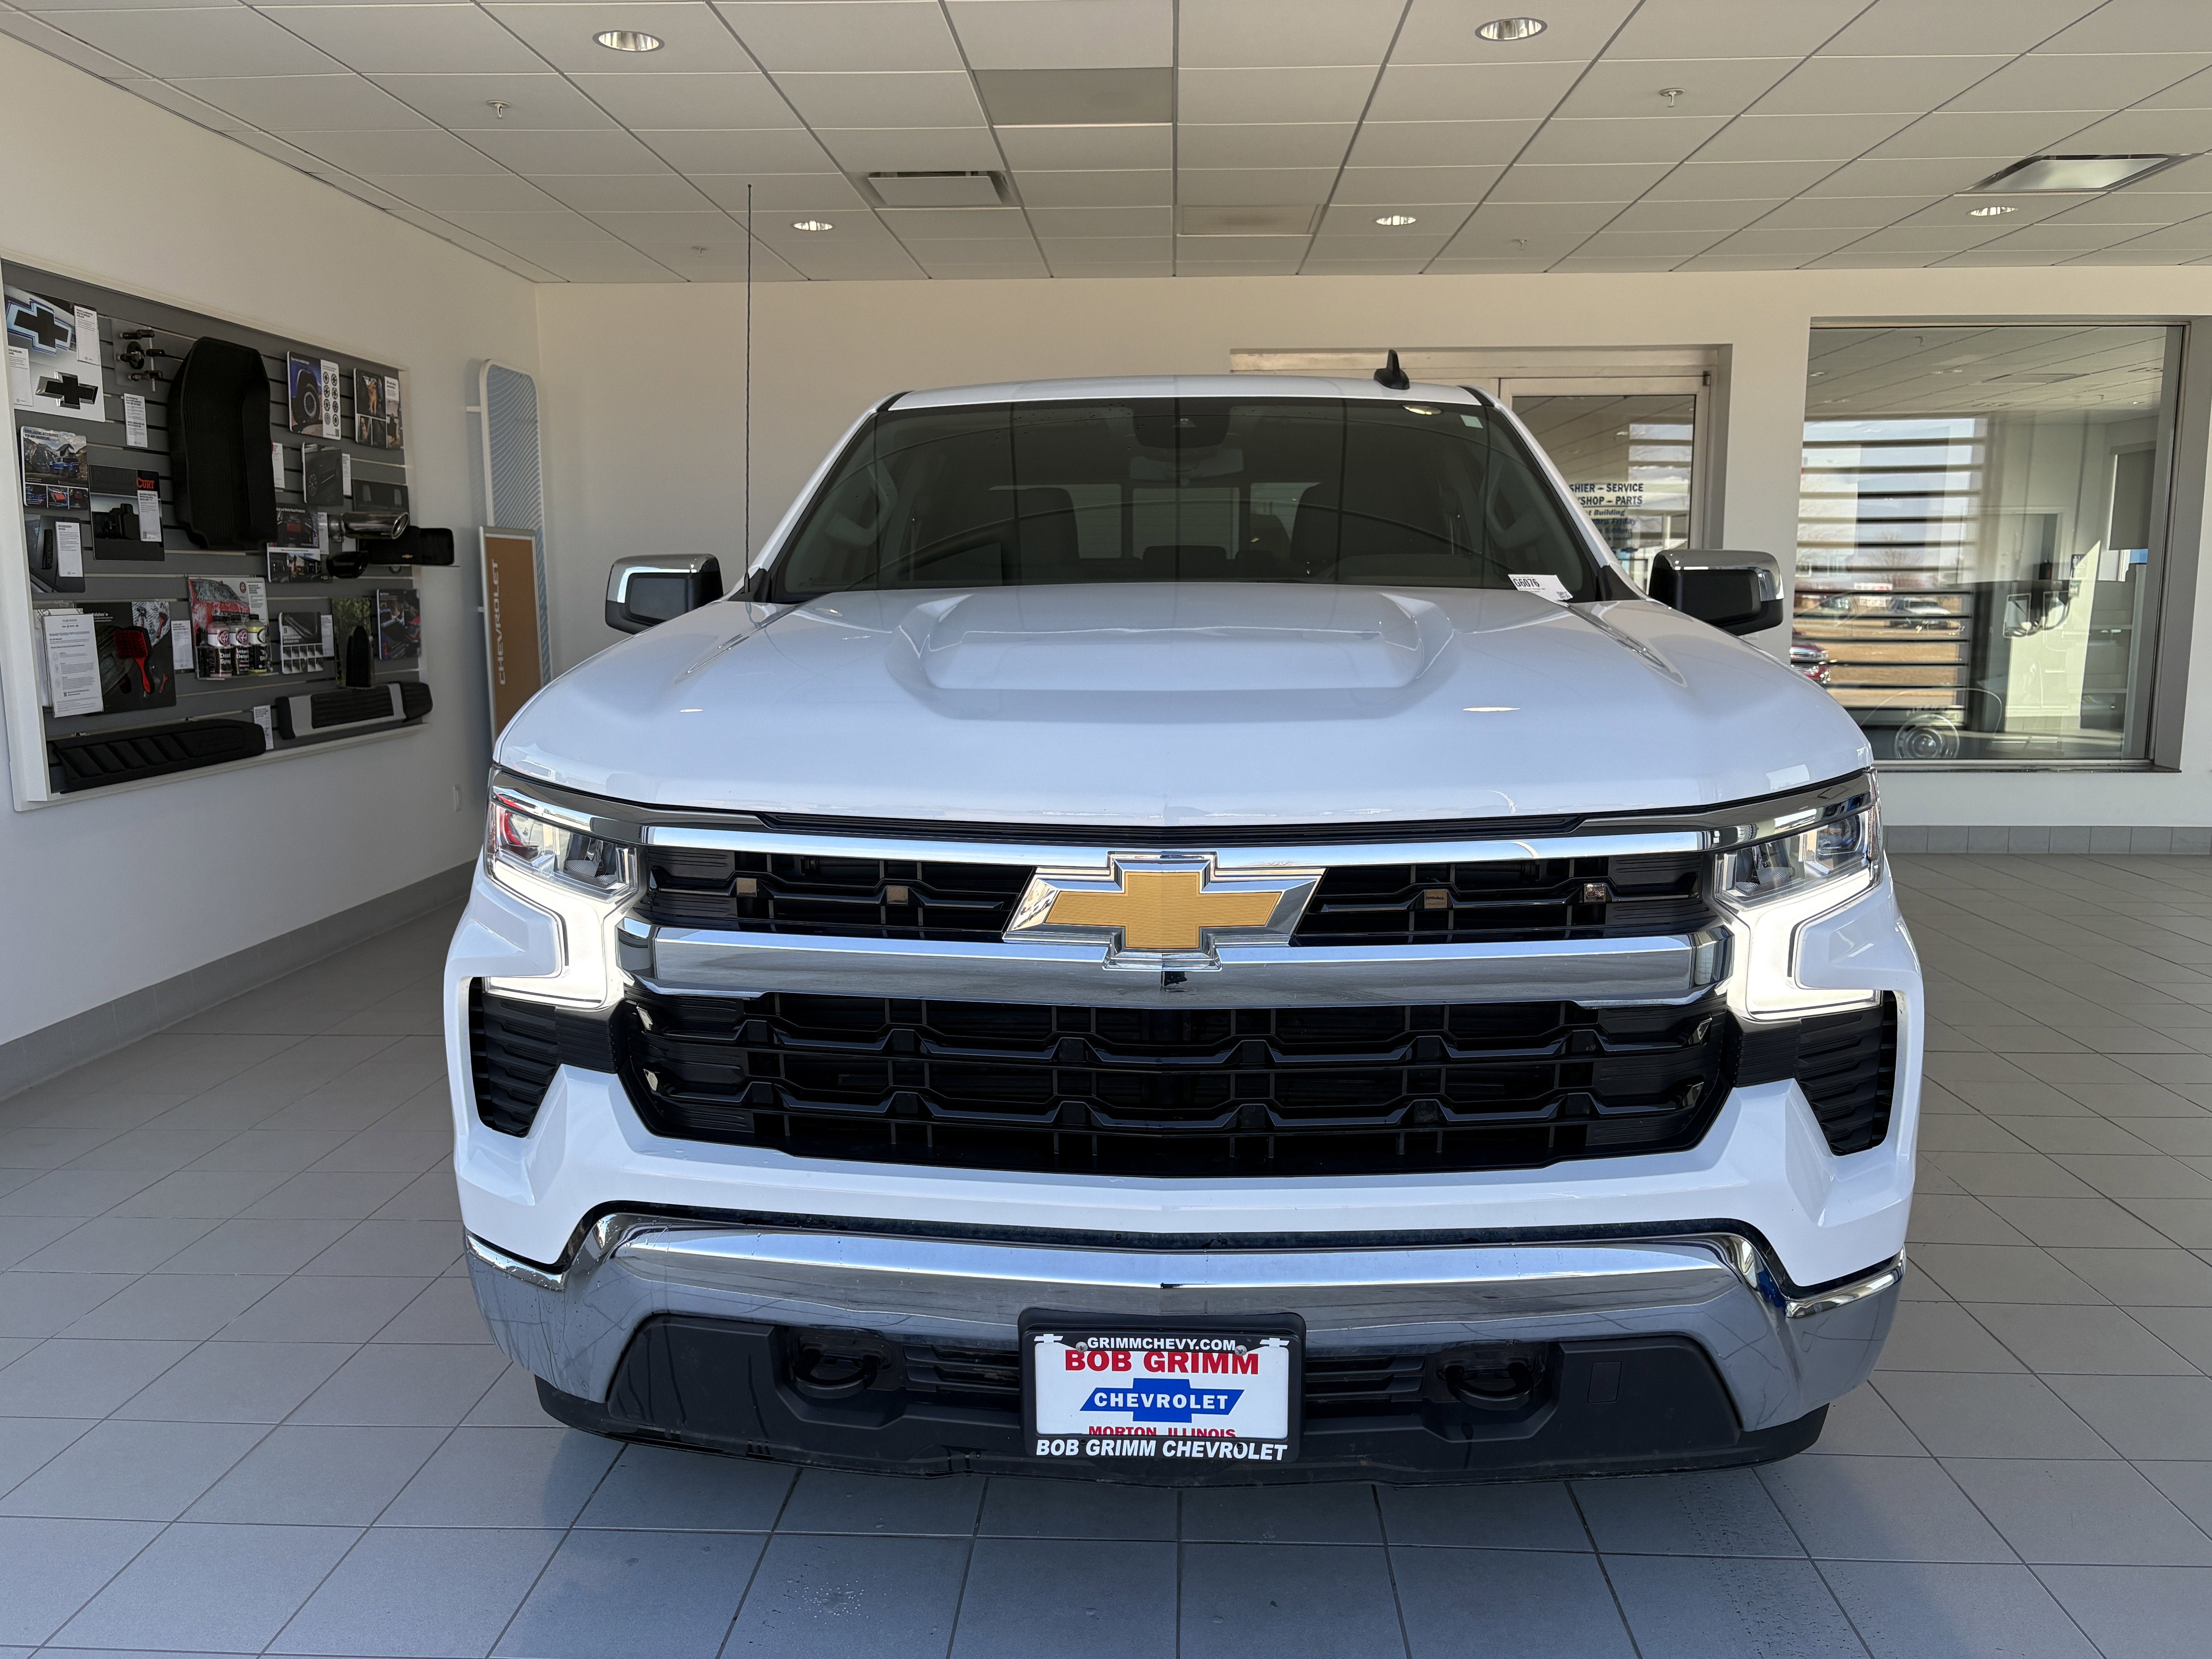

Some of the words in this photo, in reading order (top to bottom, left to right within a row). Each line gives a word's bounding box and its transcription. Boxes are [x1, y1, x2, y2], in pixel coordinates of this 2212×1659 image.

[1606, 483, 1644, 493] SERVICE
[1616, 496, 1642, 505] PARTS
[1513, 579, 1540, 587] G6076
[492, 558, 506, 685] CHEVROLET
[1087, 1337, 1236, 1351] GRIMMCHEVY.COM
[1065, 1350, 1132, 1371] BOB
[1144, 1351, 1259, 1375] GRIMM
[1094, 1392, 1228, 1409] CHEVROLET
[1168, 1427, 1236, 1437] ILLINOIS
[1036, 1439, 1079, 1456] BOB
[1086, 1439, 1156, 1456] GRIMM
[1162, 1440, 1288, 1461] CHEVROLET
